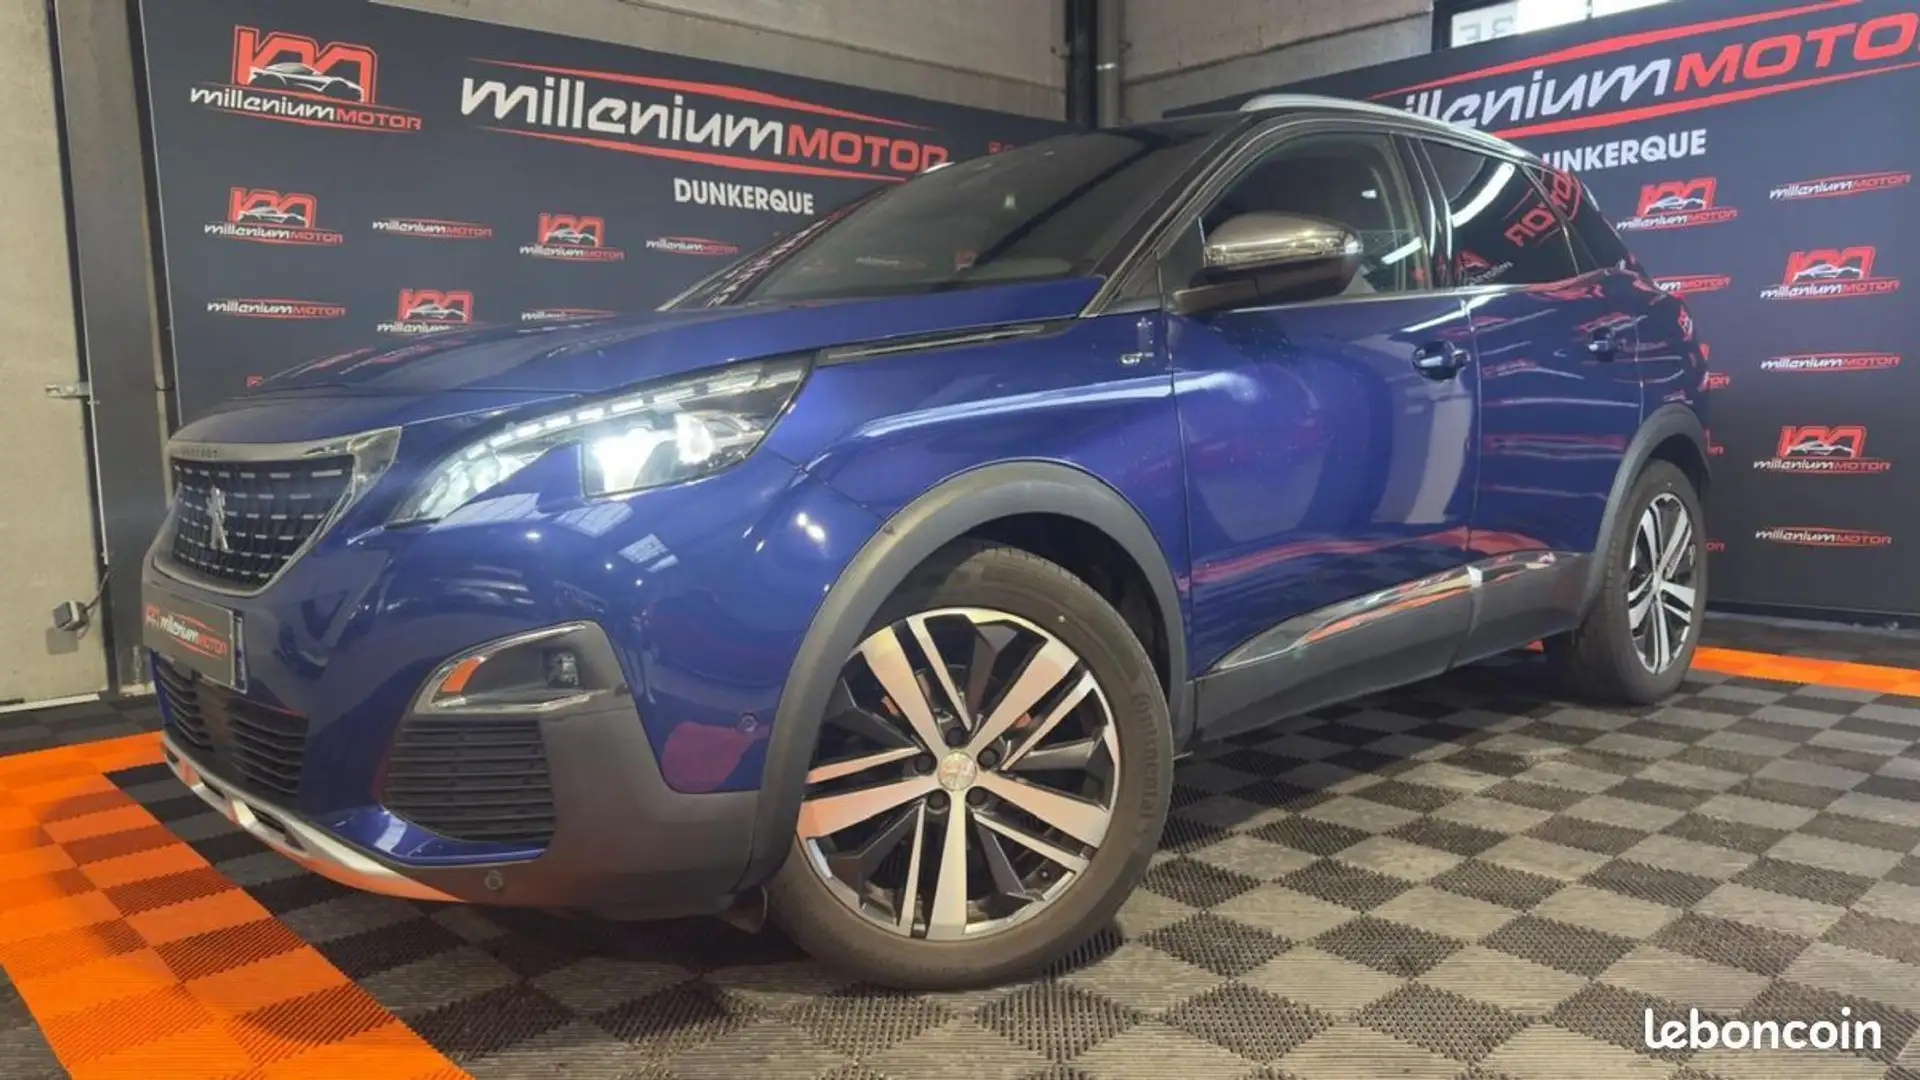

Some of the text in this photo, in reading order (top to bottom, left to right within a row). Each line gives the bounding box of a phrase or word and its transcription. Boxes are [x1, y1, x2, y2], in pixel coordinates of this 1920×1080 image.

[1404, 13, 1920, 129] illeniumMOTO
[190, 87, 422, 130] milleniumMOTOR
[1542, 129, 1708, 173] UNKERQUE
[673, 177, 814, 216] DUNKERQUE
